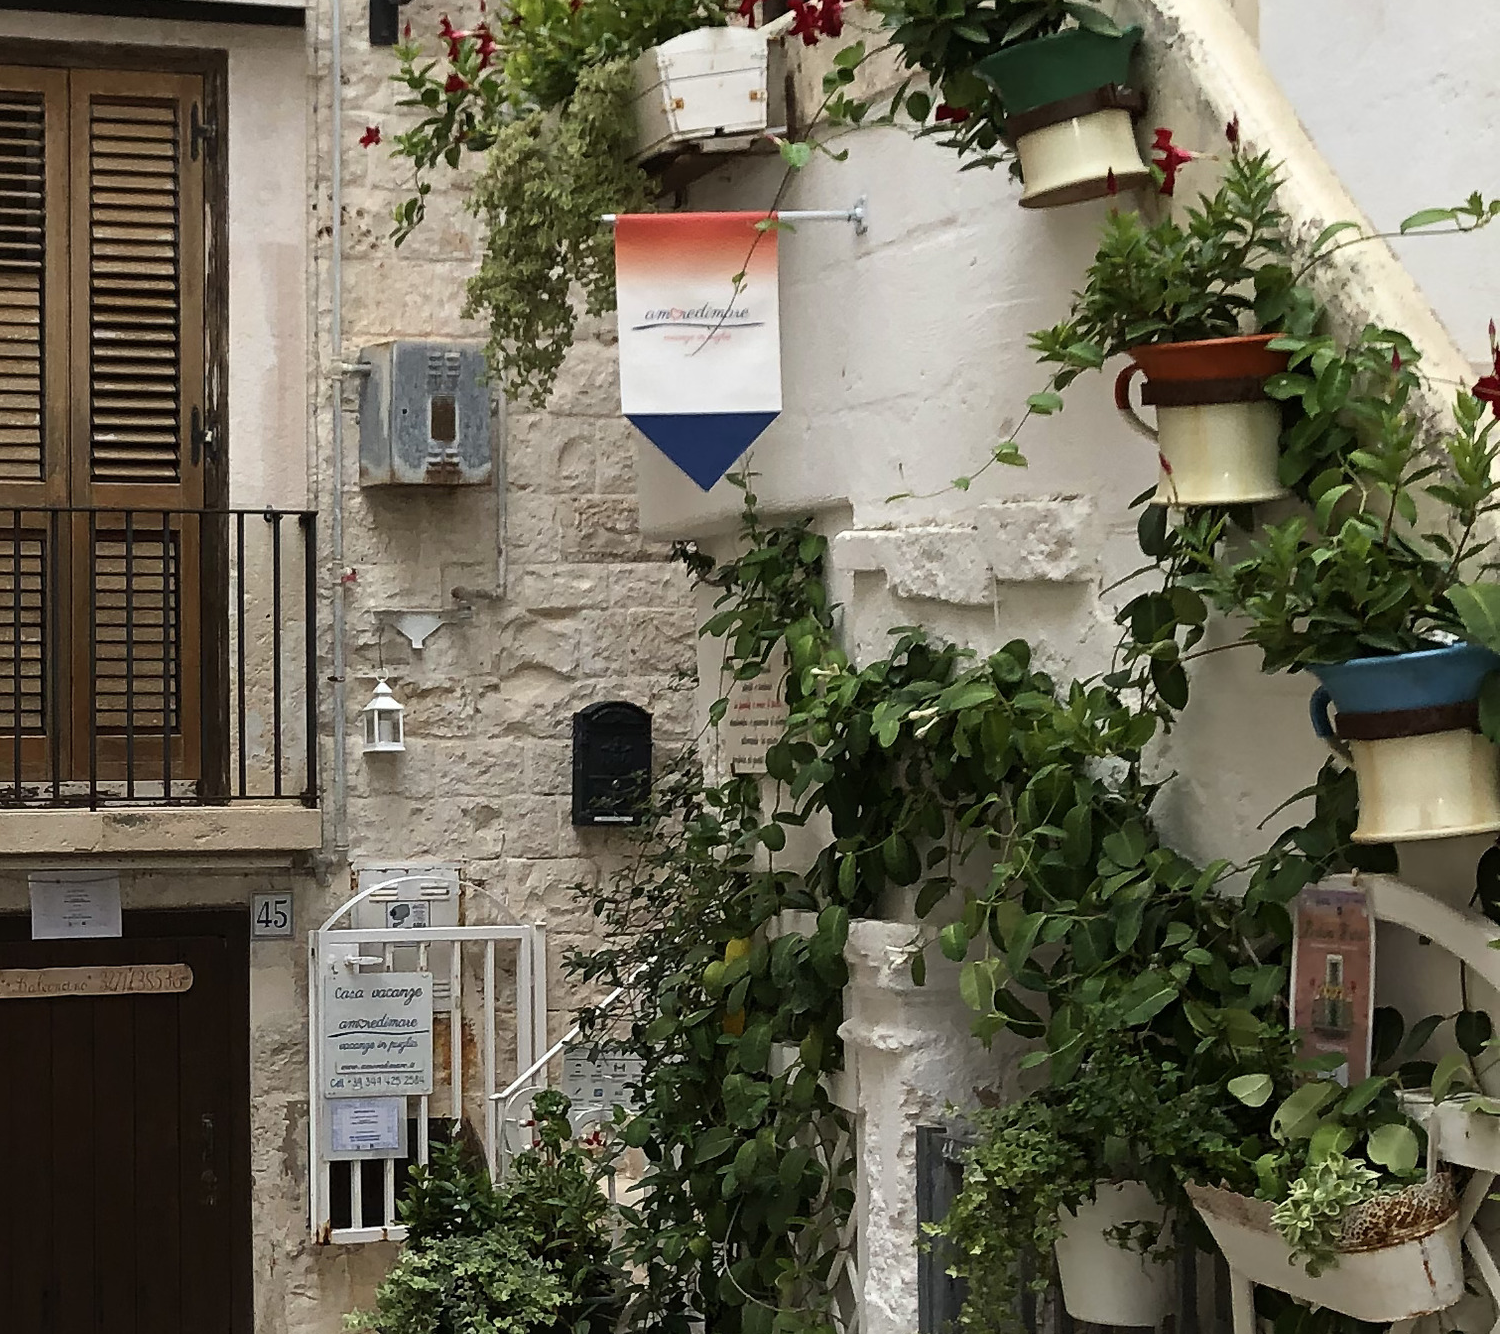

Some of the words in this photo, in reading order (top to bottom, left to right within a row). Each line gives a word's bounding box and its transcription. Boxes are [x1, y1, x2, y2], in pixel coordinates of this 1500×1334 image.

[256, 899, 288, 929] 45
[334, 986, 365, 1000] Casa
[371, 987, 424, 1006] vacanze
